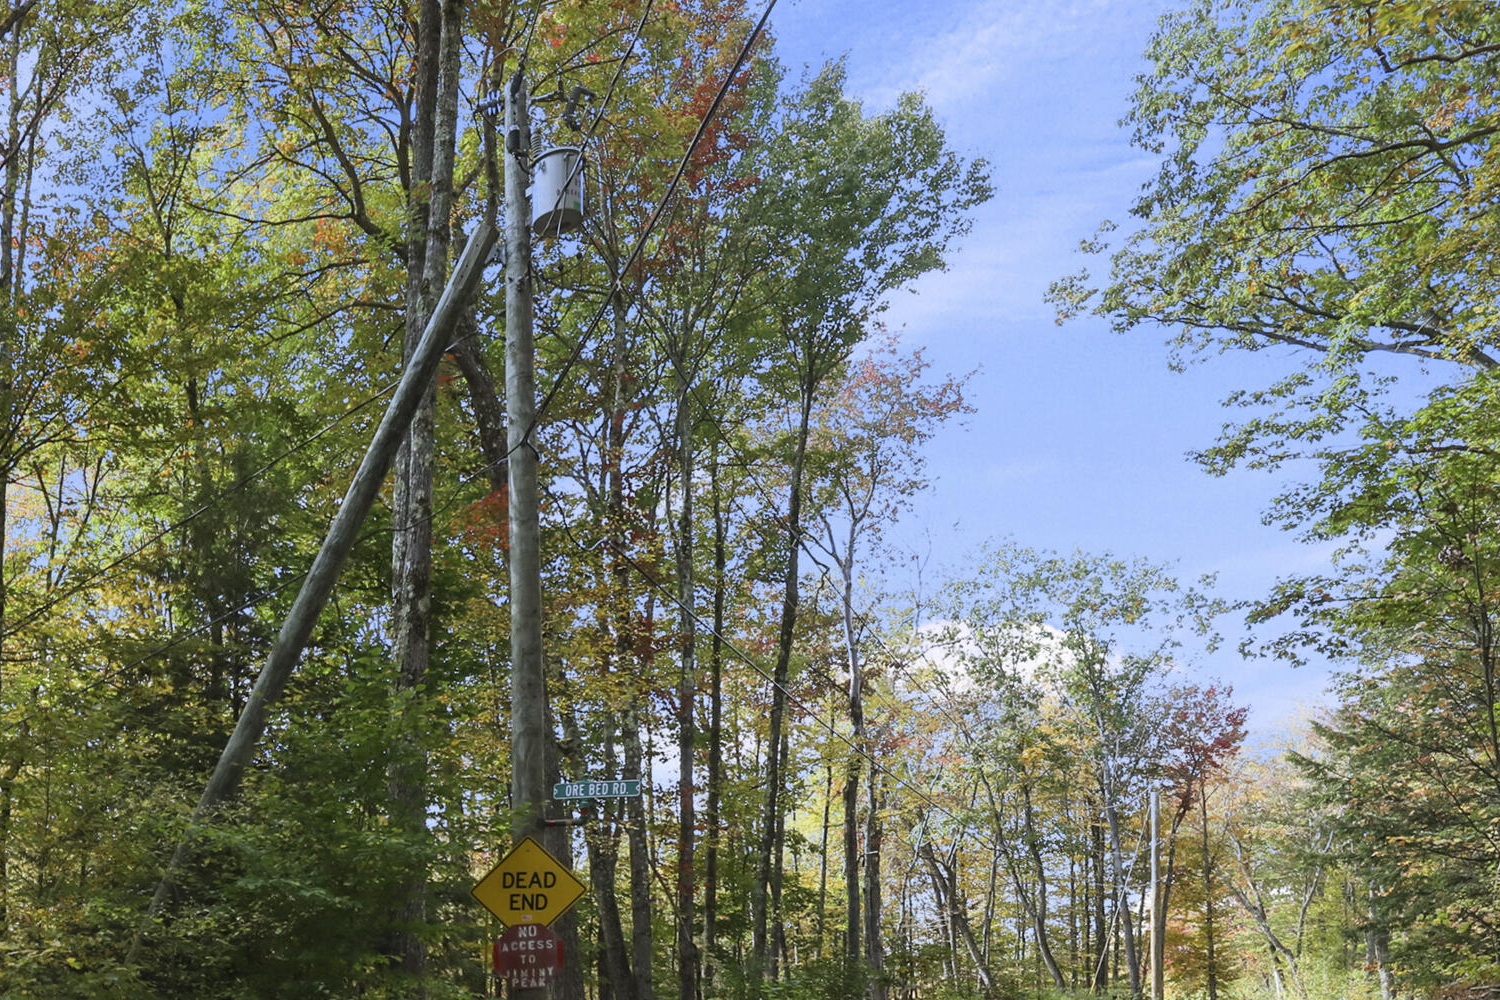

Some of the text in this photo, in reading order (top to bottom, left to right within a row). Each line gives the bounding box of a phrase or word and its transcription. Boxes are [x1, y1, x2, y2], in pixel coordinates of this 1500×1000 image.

[565, 782, 629, 796] ORE BED RD.
[503, 871, 557, 889] DEAD
[510, 893, 548, 911] END
[518, 925, 537, 938] NO
[502, 940, 553, 952] ACCESS
[520, 954, 536, 964] TO
[504, 966, 554, 979] JIMINY
[512, 979, 546, 988] PEAK
